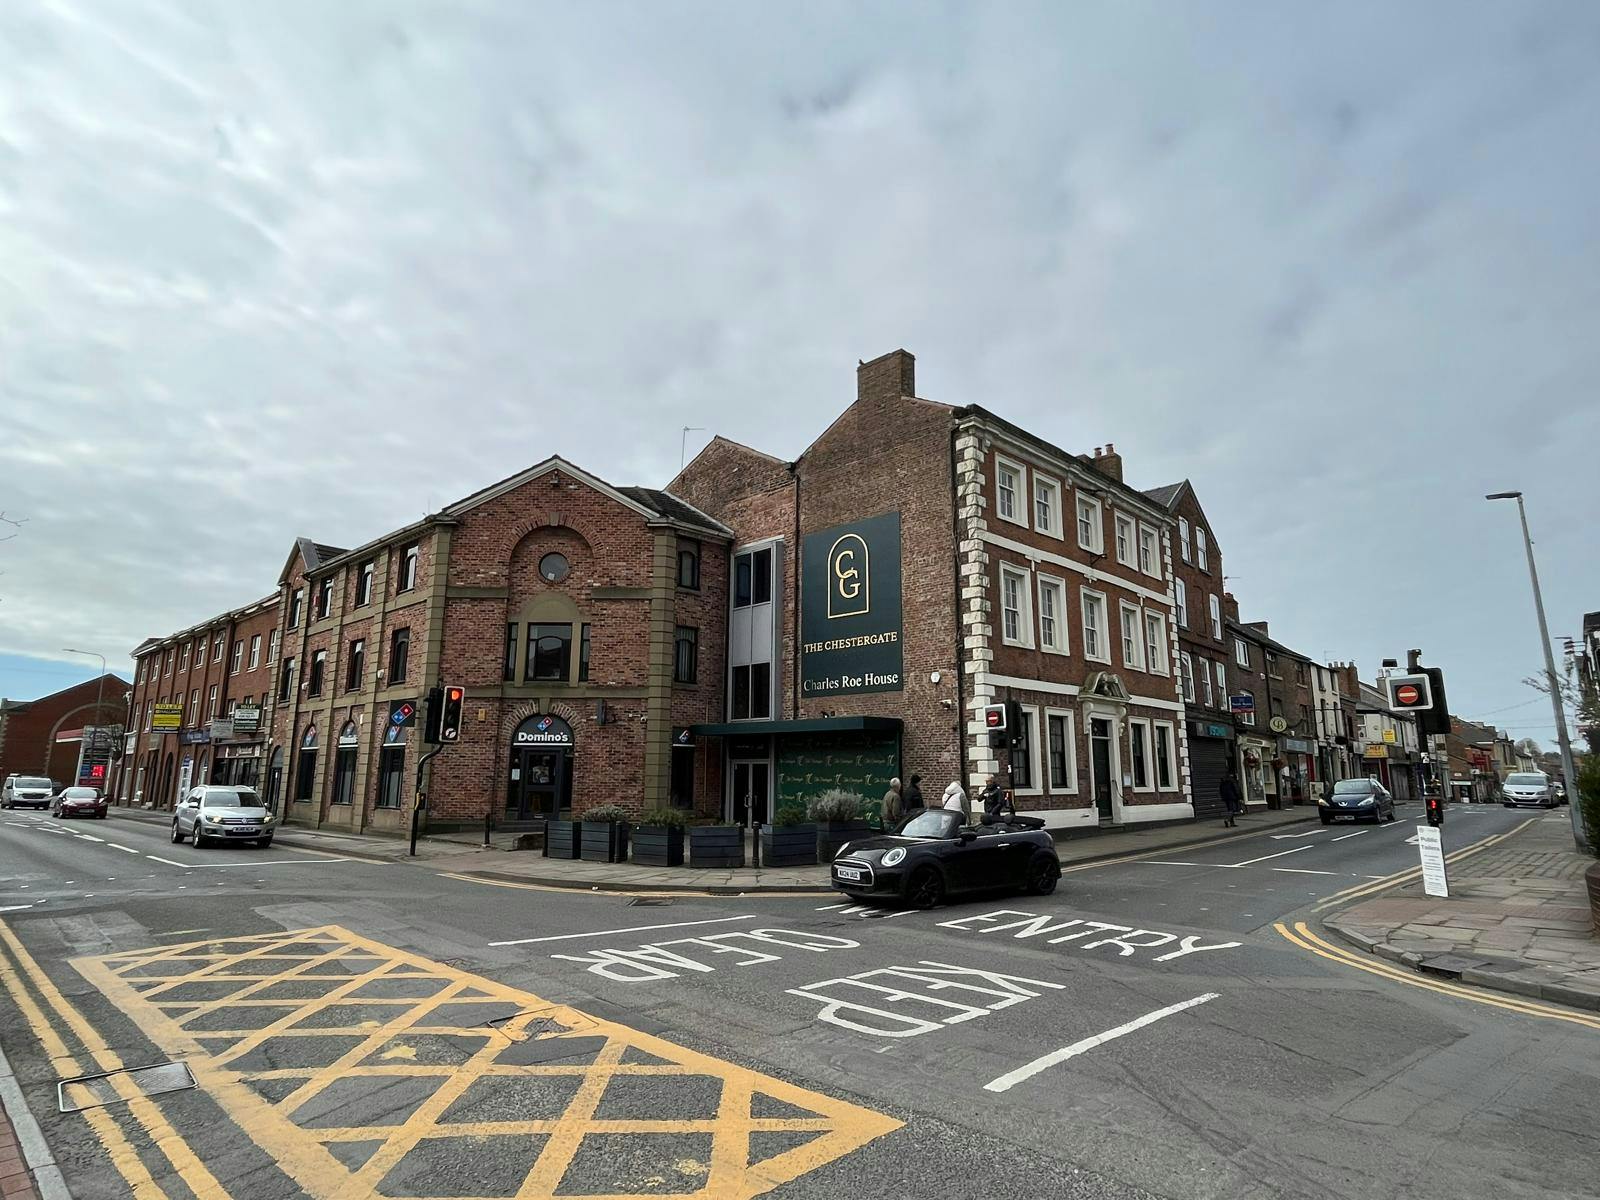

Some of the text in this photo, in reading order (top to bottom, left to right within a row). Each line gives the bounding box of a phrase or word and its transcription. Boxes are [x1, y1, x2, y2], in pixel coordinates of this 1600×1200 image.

[804, 631, 898, 653] THE CHESTERGATE
[803, 672, 899, 691] Charles Roe House
[518, 731, 568, 742] Domino's
[936, 910, 1243, 961] ENTRY
[550, 928, 861, 982] CLEAR
[785, 961, 1066, 1037] KEEP
